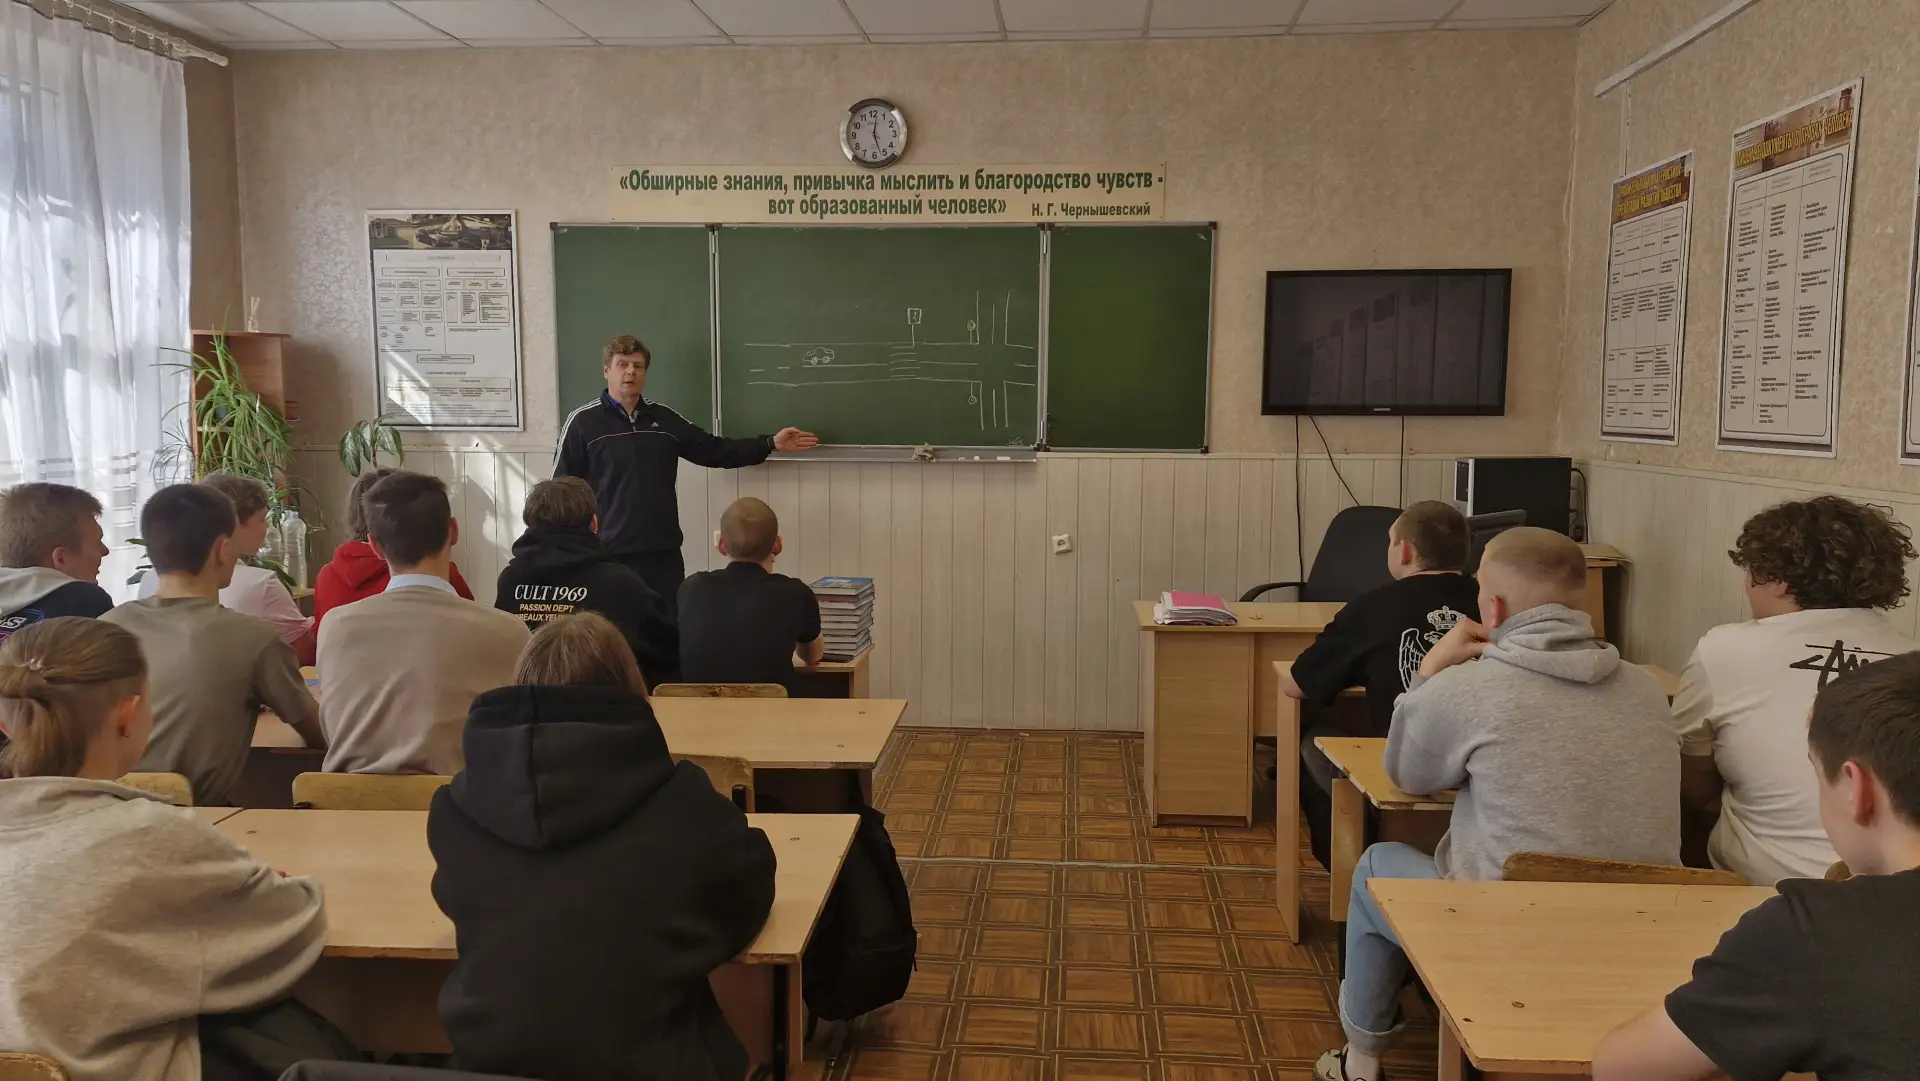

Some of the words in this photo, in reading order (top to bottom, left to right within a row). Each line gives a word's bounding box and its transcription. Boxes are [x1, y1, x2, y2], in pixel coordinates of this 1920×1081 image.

[869, 110, 878, 118] 12
[882, 112, 886, 120] 1
[853, 122, 861, 130] 10
[888, 120, 894, 128] 2
[892, 130, 897, 138] 3
[855, 142, 860, 150] 8
[862, 149, 867, 157] 7
[619, 169, 718, 195] «Обширные
[723, 174, 788, 195] знания,
[793, 175, 875, 195] привычка
[880, 173, 954, 190] мыслить
[959, 174, 969, 190] и
[974, 168, 1092, 194] благородство
[1096, 172, 1153, 194] чувств
[768, 198, 795, 215] вот
[799, 194, 923, 220] образованный
[928, 198, 1007, 215] человек»
[1031, 202, 1044, 217] Н.
[1047, 202, 1058, 217] Г.
[1060, 202, 1151, 220] Чернышевский
[514, 584, 552, 601] CULT
[551, 586, 588, 602] 1969
[519, 603, 552, 612] PASSION
[552, 604, 574, 613] DEPT
